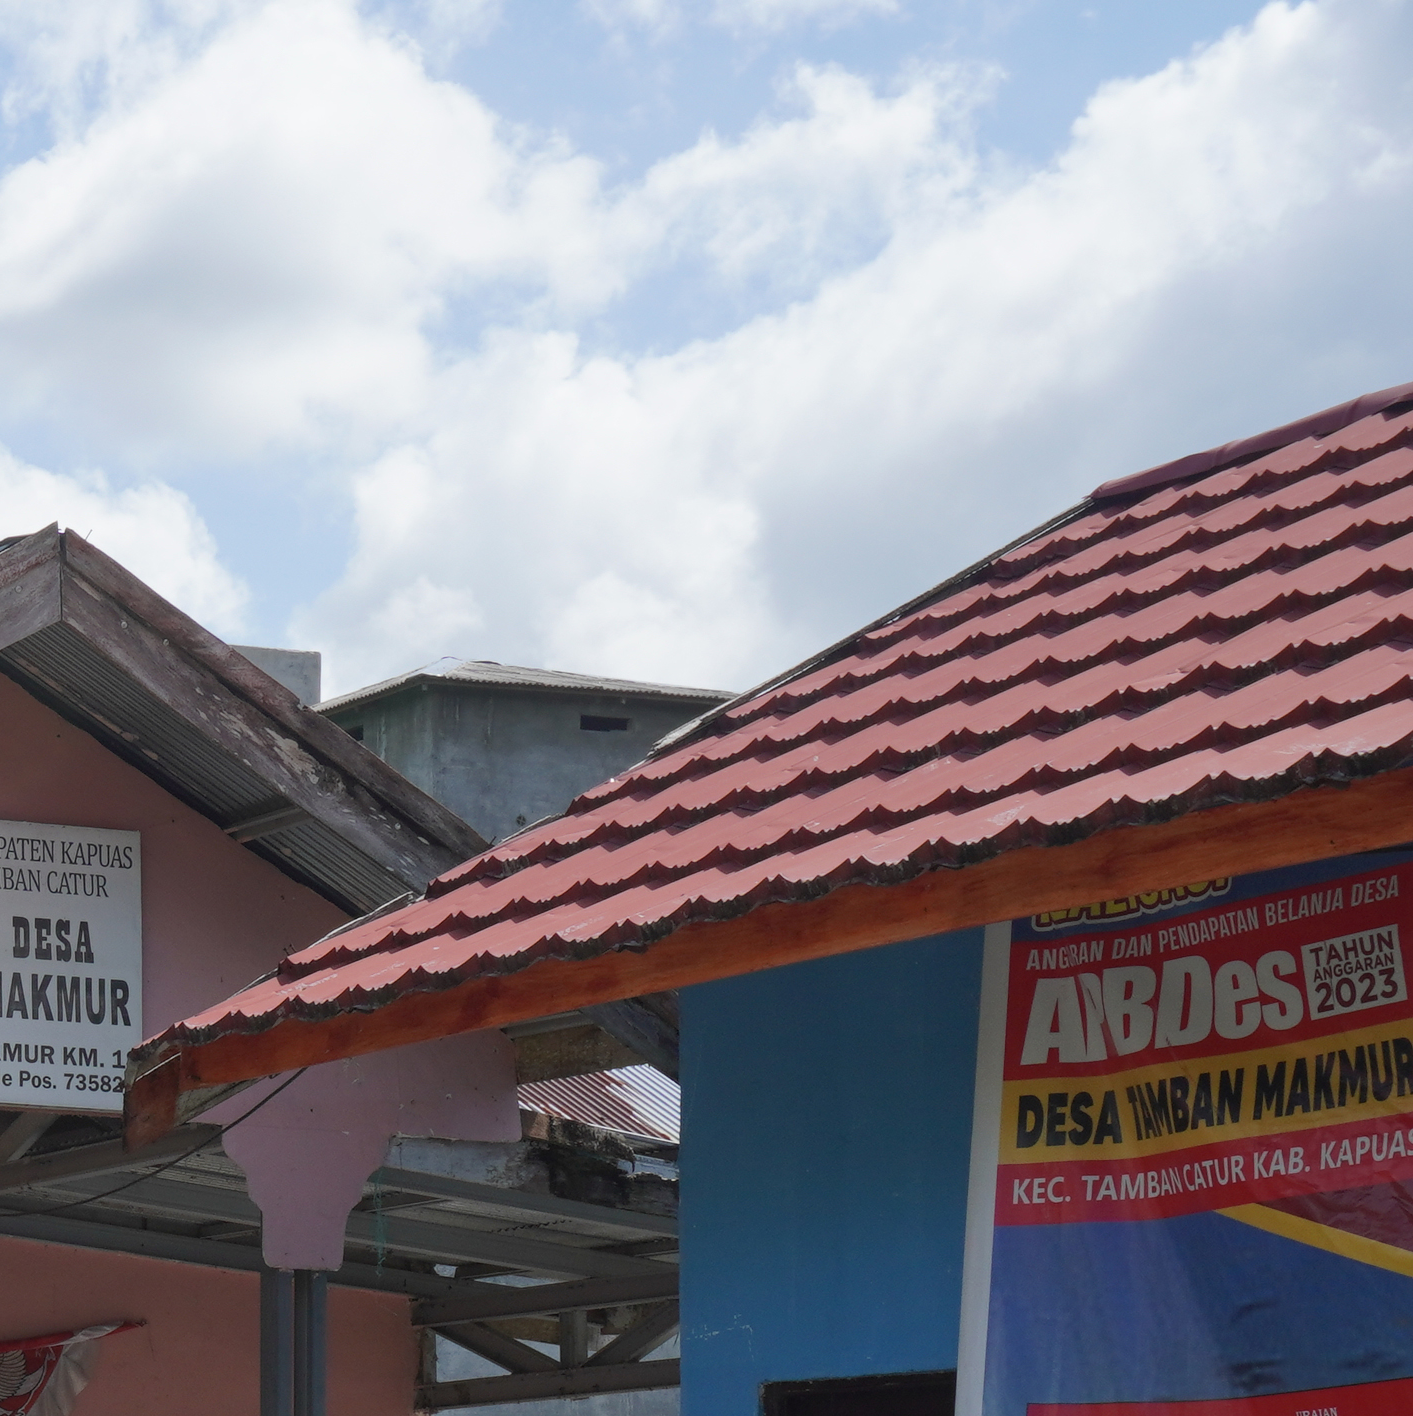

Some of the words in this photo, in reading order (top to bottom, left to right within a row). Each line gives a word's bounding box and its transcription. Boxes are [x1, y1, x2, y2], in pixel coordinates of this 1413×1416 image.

[61, 842, 133, 869] KAPUAS
[46, 871, 109, 897] CATUR
[1111, 934, 1152, 960] DAN
[1159, 908, 1258, 953] PENDAPATAN
[1266, 887, 1343, 927] BELANJA
[1350, 875, 1399, 907] DESA
[13, 916, 94, 964] DESA
[1309, 932, 1394, 962] TAHUN
[1314, 953, 1395, 981] ANGGARAN
[1316, 967, 1399, 1014] 2023
[63, 1047, 104, 1068] KM.
[20, 1071, 56, 1090] Pos.
[64, 1074, 124, 1093] 73582
[1016, 1090, 1122, 1149] DESA
[1127, 1067, 1244, 1141] TAMBAN
[1253, 1037, 1413, 1120] MAKMUR
[1013, 1177, 1070, 1204] KEC.
[1082, 1167, 1183, 1201] TAMBAN
[1185, 1155, 1245, 1191] CATUR
[1254, 1146, 1311, 1179] KAB.
